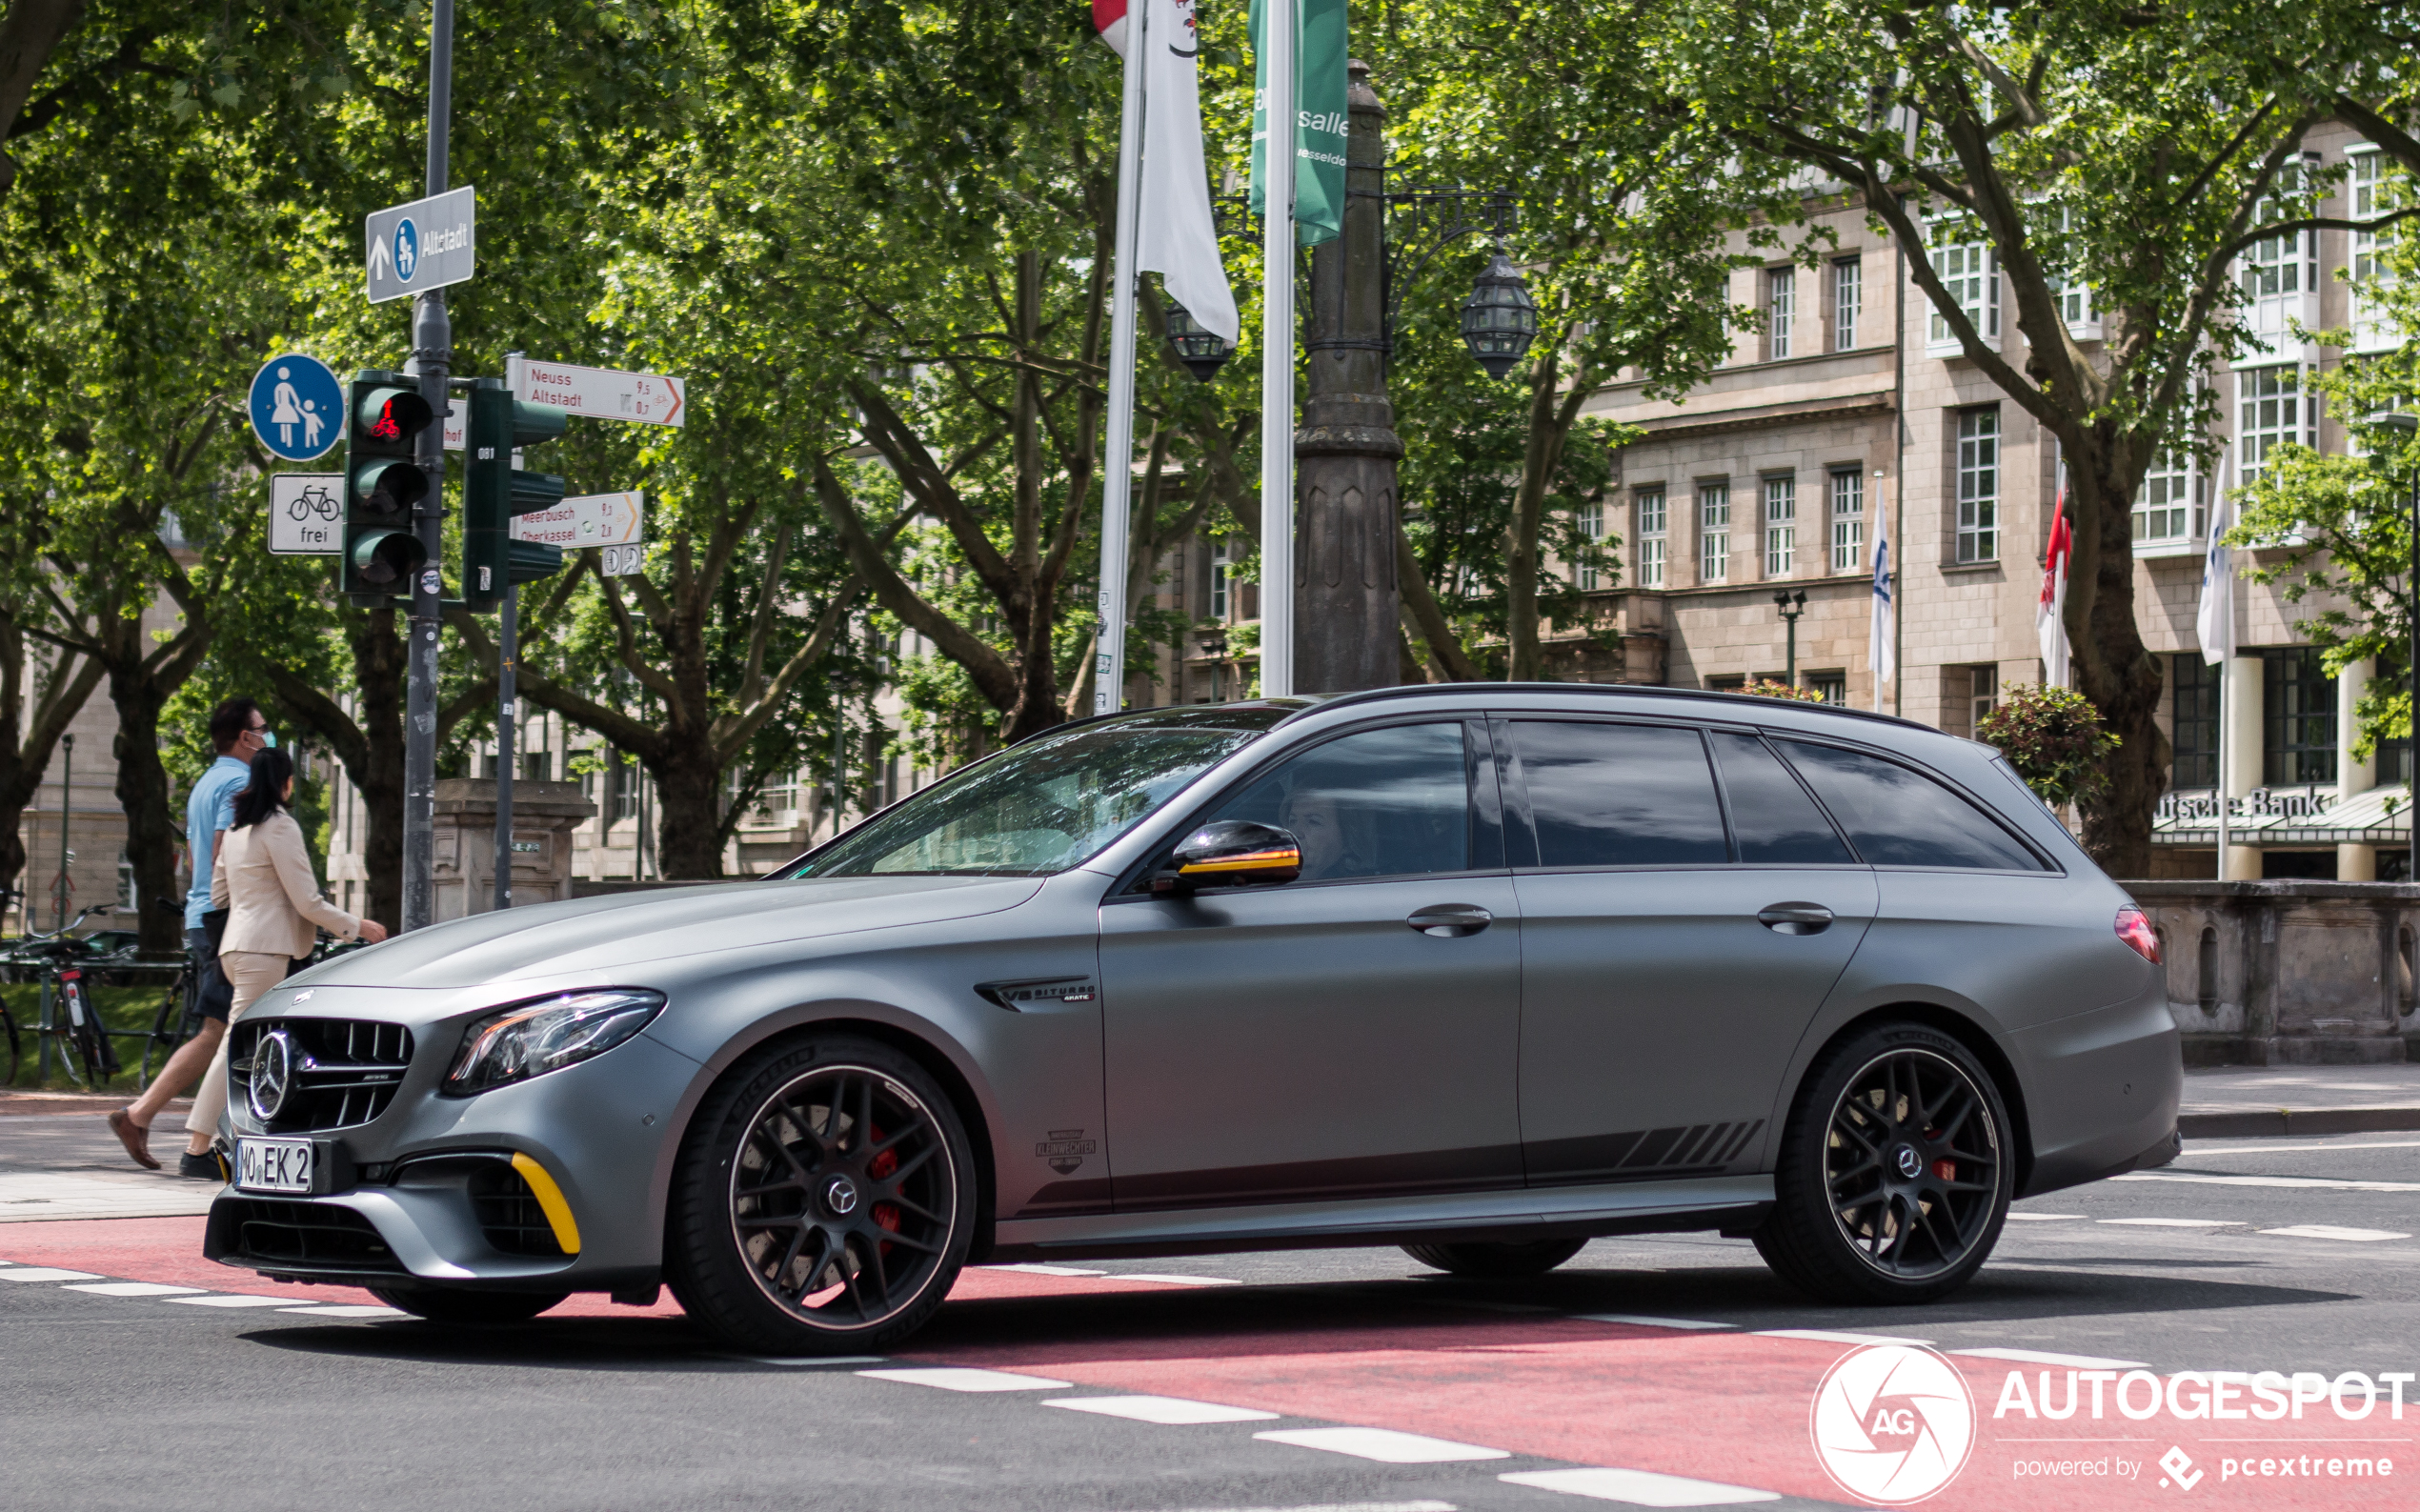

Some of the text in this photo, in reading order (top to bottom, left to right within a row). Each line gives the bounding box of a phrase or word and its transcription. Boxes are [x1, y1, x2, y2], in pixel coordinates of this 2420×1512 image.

[422, 222, 468, 258] Altstadt
[531, 369, 572, 386] Neuss
[531, 389, 582, 408] Altstadt
[444, 428, 462, 442] hof
[521, 507, 575, 524] Meerbusch
[301, 527, 328, 542] frei
[520, 527, 576, 542] Oberkassel
[2153, 785, 2325, 819] utsche Bank
[1034, 985, 1095, 997] BITURBO
[264, 1146, 291, 1183] EK
[295, 1147, 309, 1184] 2
